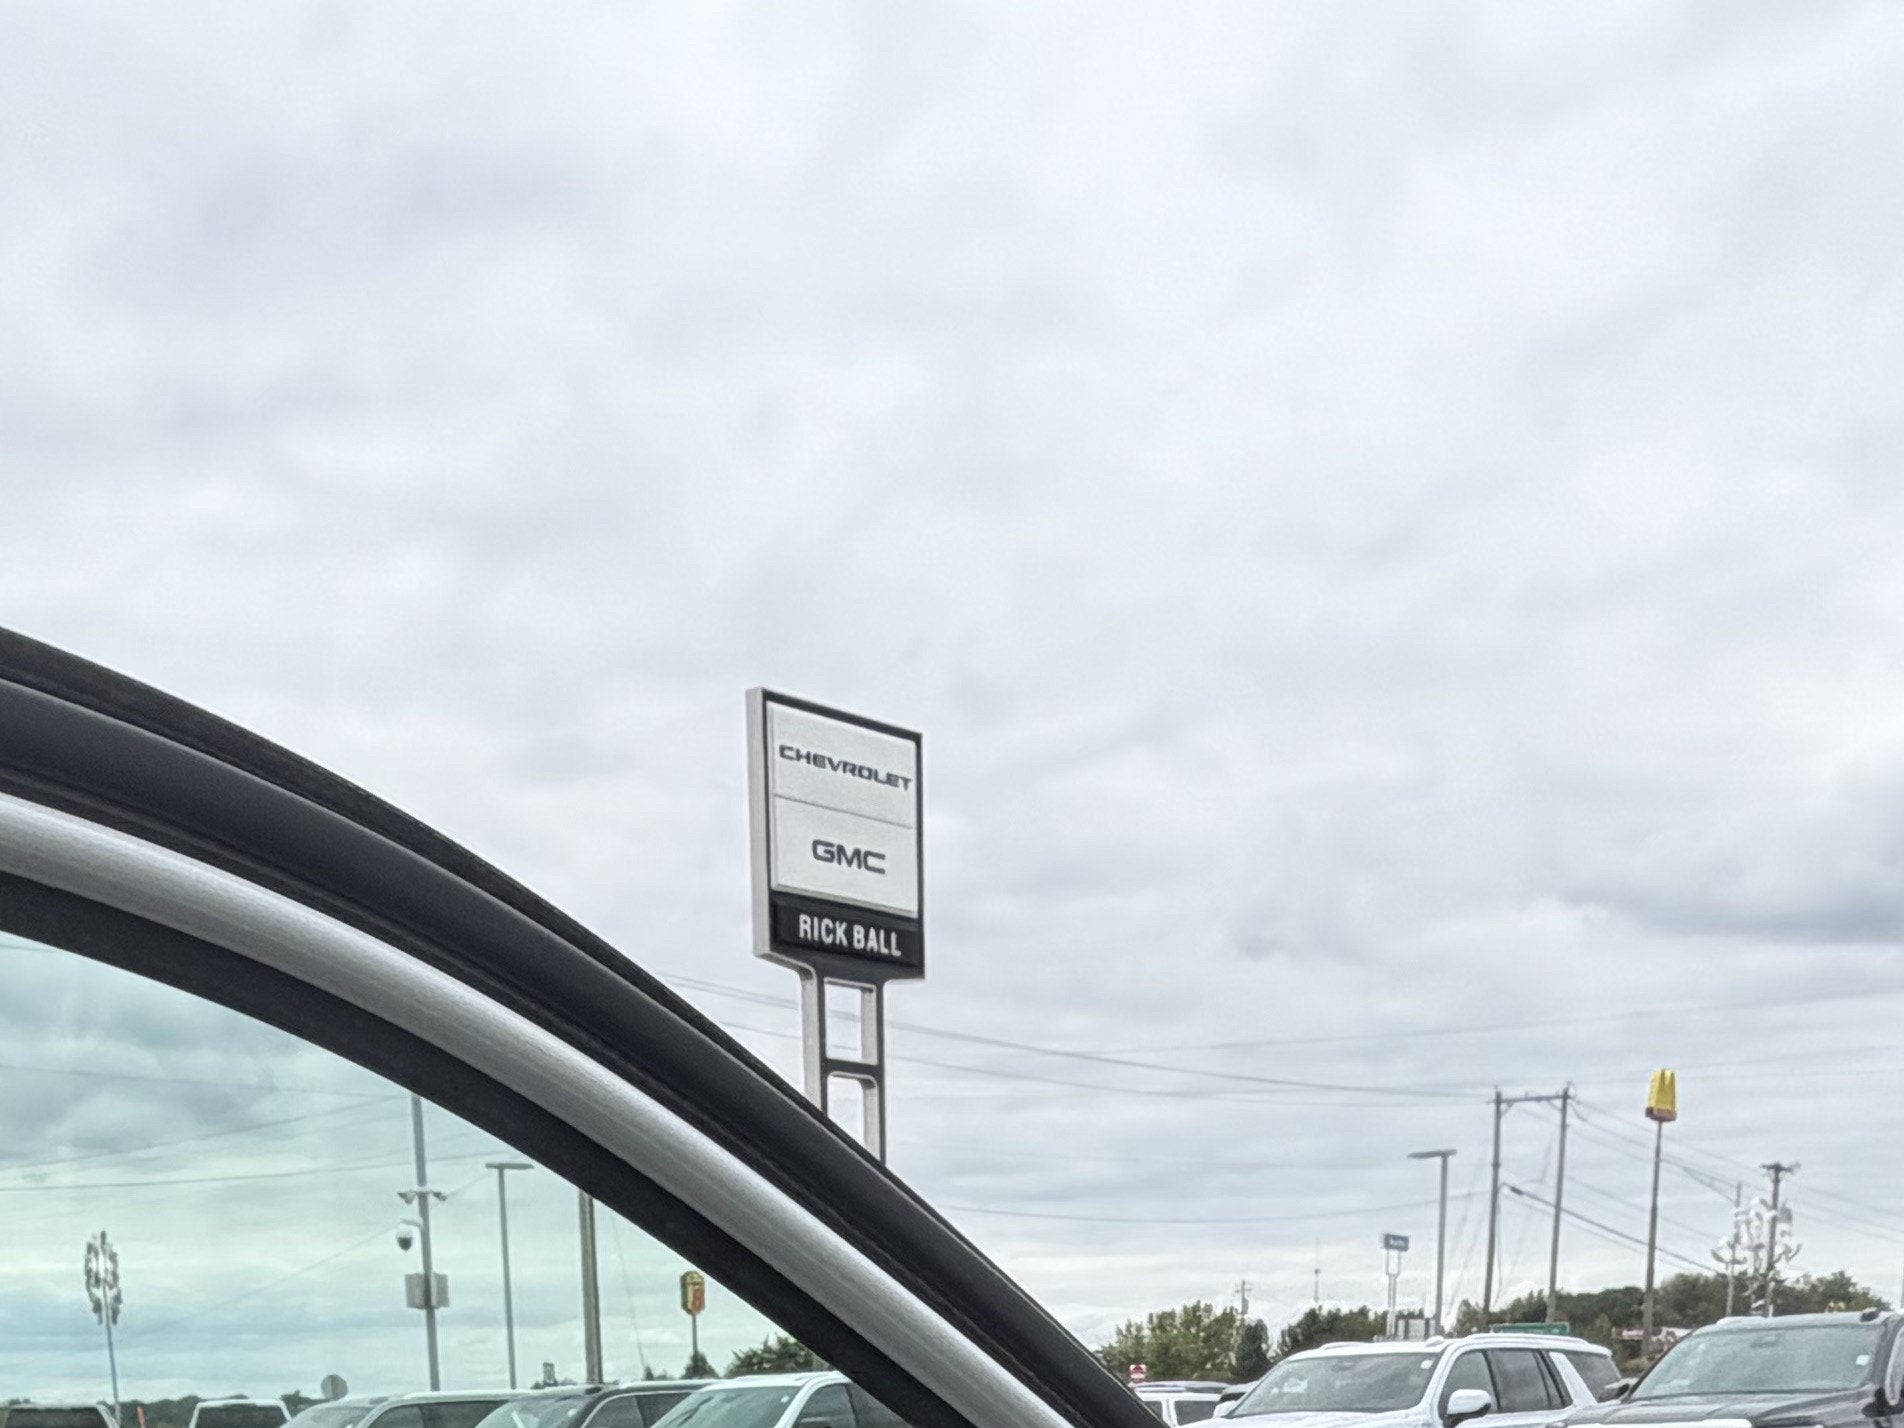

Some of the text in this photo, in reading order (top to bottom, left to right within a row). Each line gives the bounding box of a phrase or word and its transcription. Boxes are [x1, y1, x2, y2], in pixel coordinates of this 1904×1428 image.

[779, 744, 913, 791] CHEVROLET
[812, 839, 886, 875] GMC
[799, 914, 902, 957] RICK BALL
